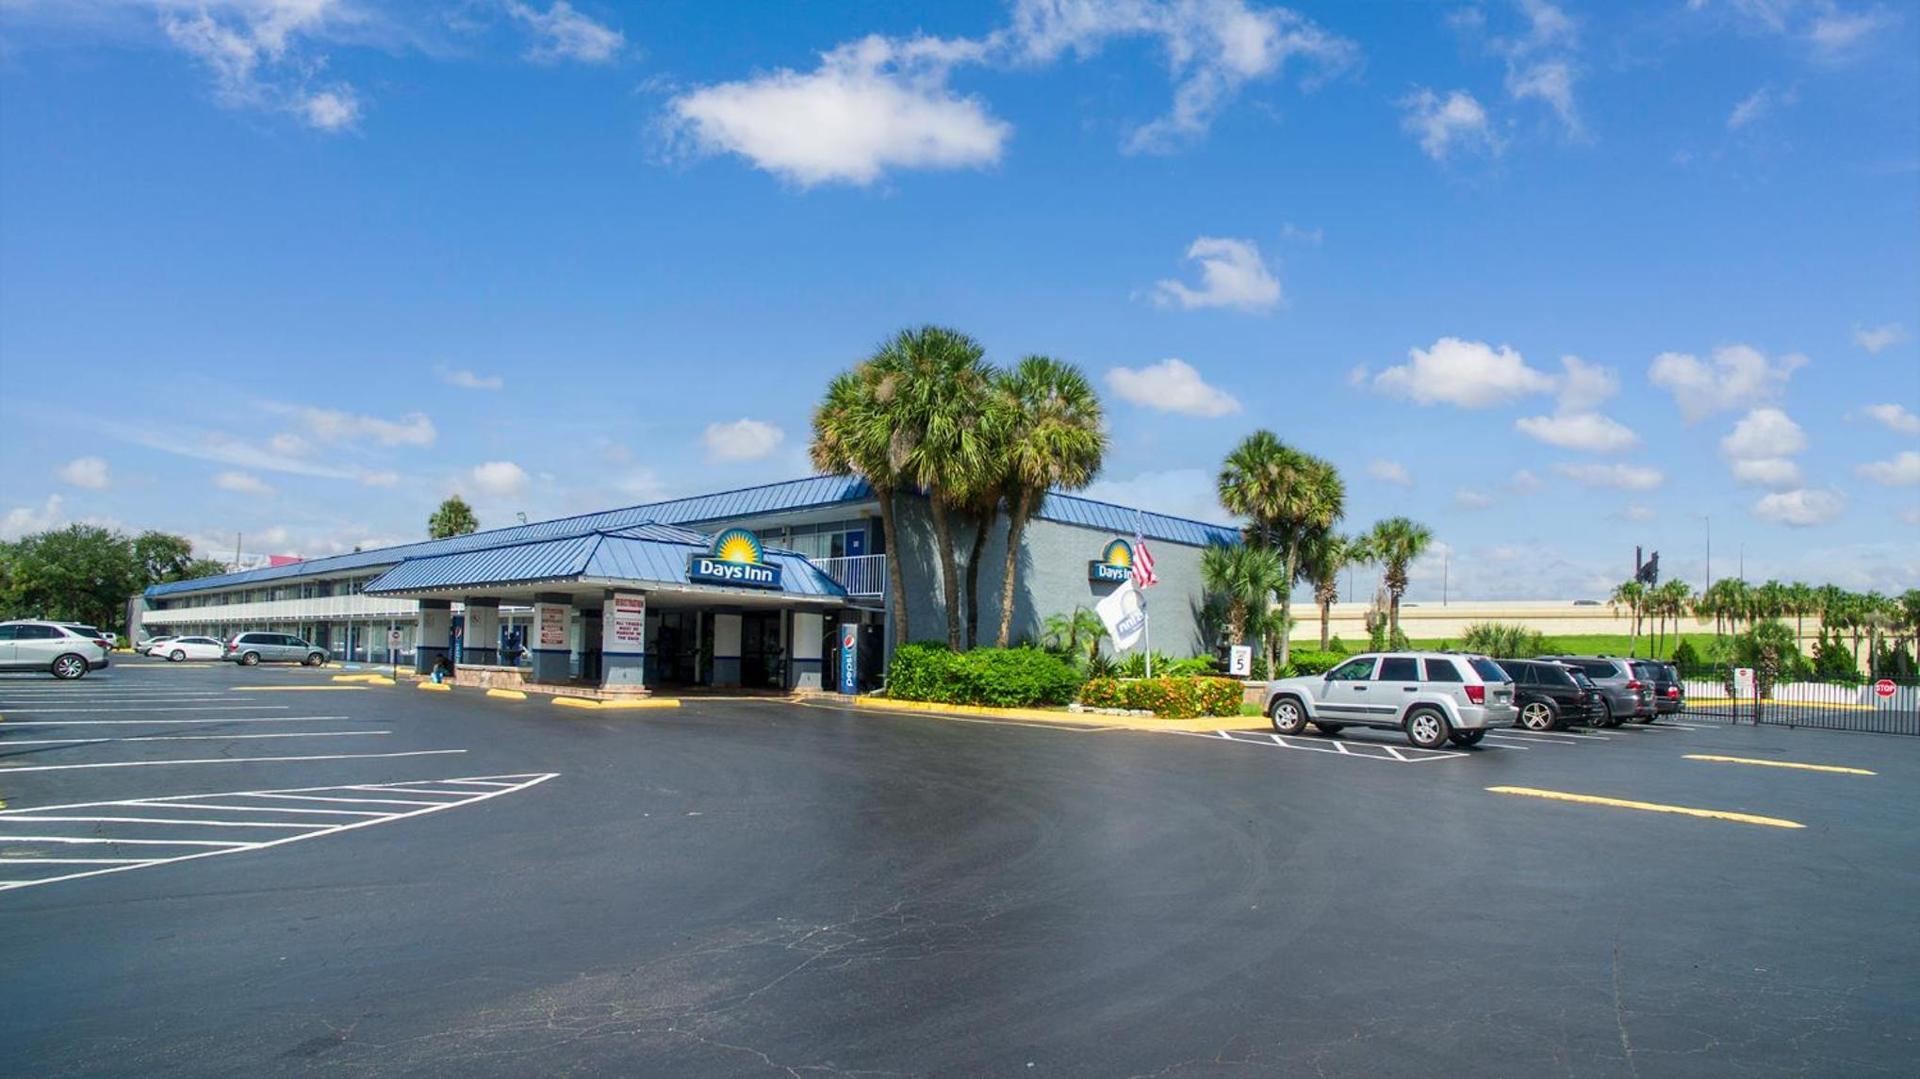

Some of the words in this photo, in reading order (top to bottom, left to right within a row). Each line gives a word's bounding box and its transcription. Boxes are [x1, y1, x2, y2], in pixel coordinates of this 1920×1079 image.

[700, 560, 743, 579] Days
[744, 565, 773, 582] Inn
[1099, 564, 1124, 580] Days
[845, 653, 853, 687] pepsi
[1237, 658, 1244, 671] 5
[1875, 684, 1895, 692] STOP
